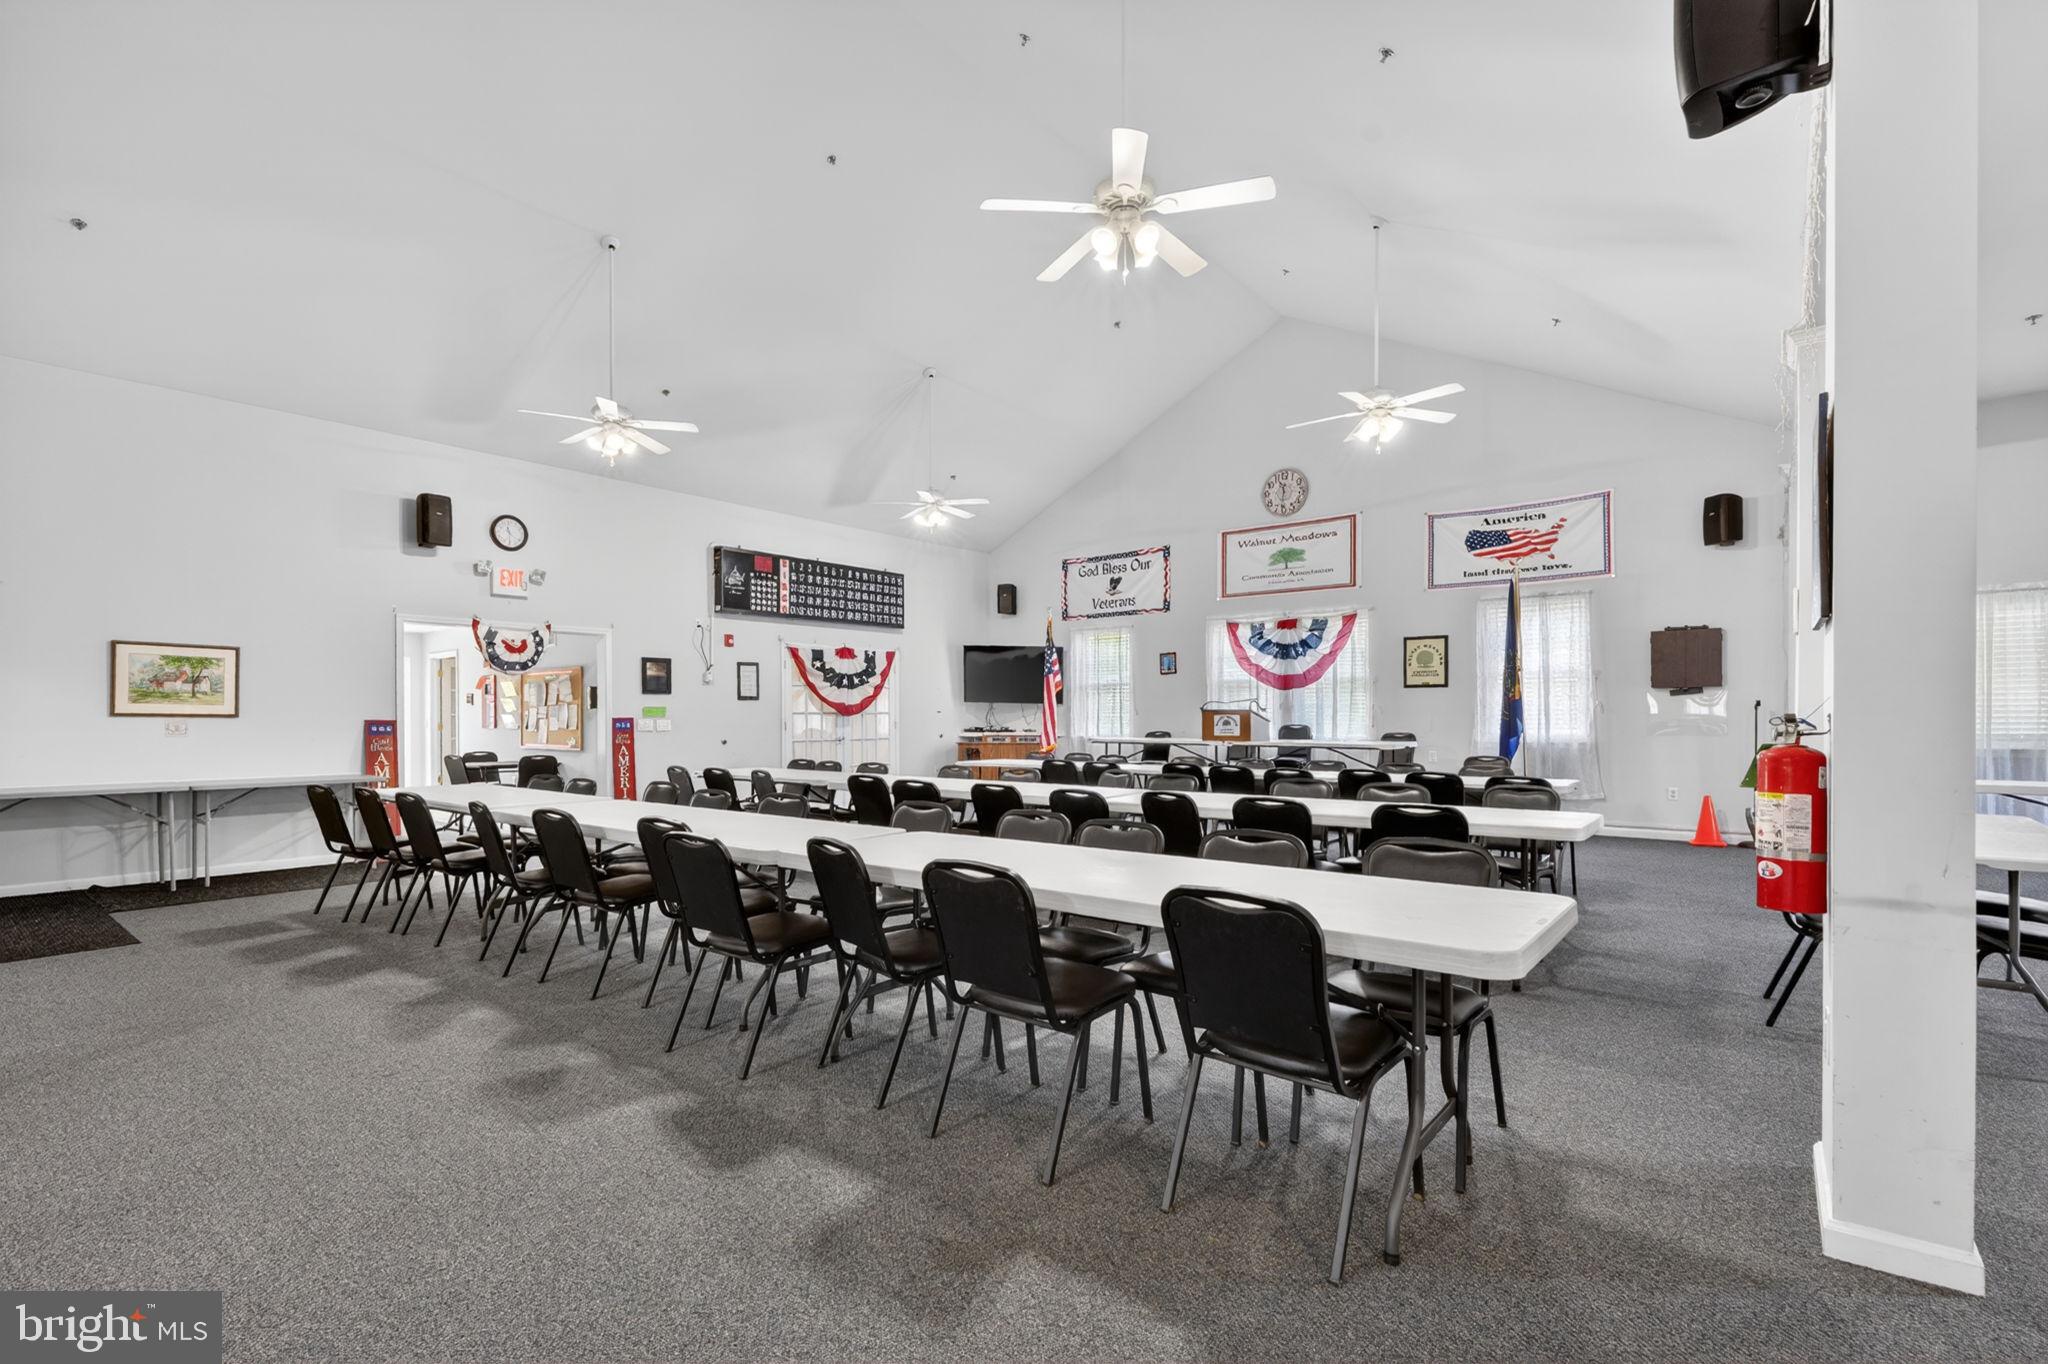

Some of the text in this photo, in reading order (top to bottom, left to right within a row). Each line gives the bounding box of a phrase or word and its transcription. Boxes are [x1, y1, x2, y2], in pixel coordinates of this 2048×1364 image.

[1480, 512, 1546, 526] America
[1238, 530, 1338, 549] Walnut Meadows
[1078, 558, 1152, 578] God Bless Our
[1463, 569, 1489, 578] land
[500, 568, 524, 588] EXIT
[1092, 597, 1136, 610] Veterans
